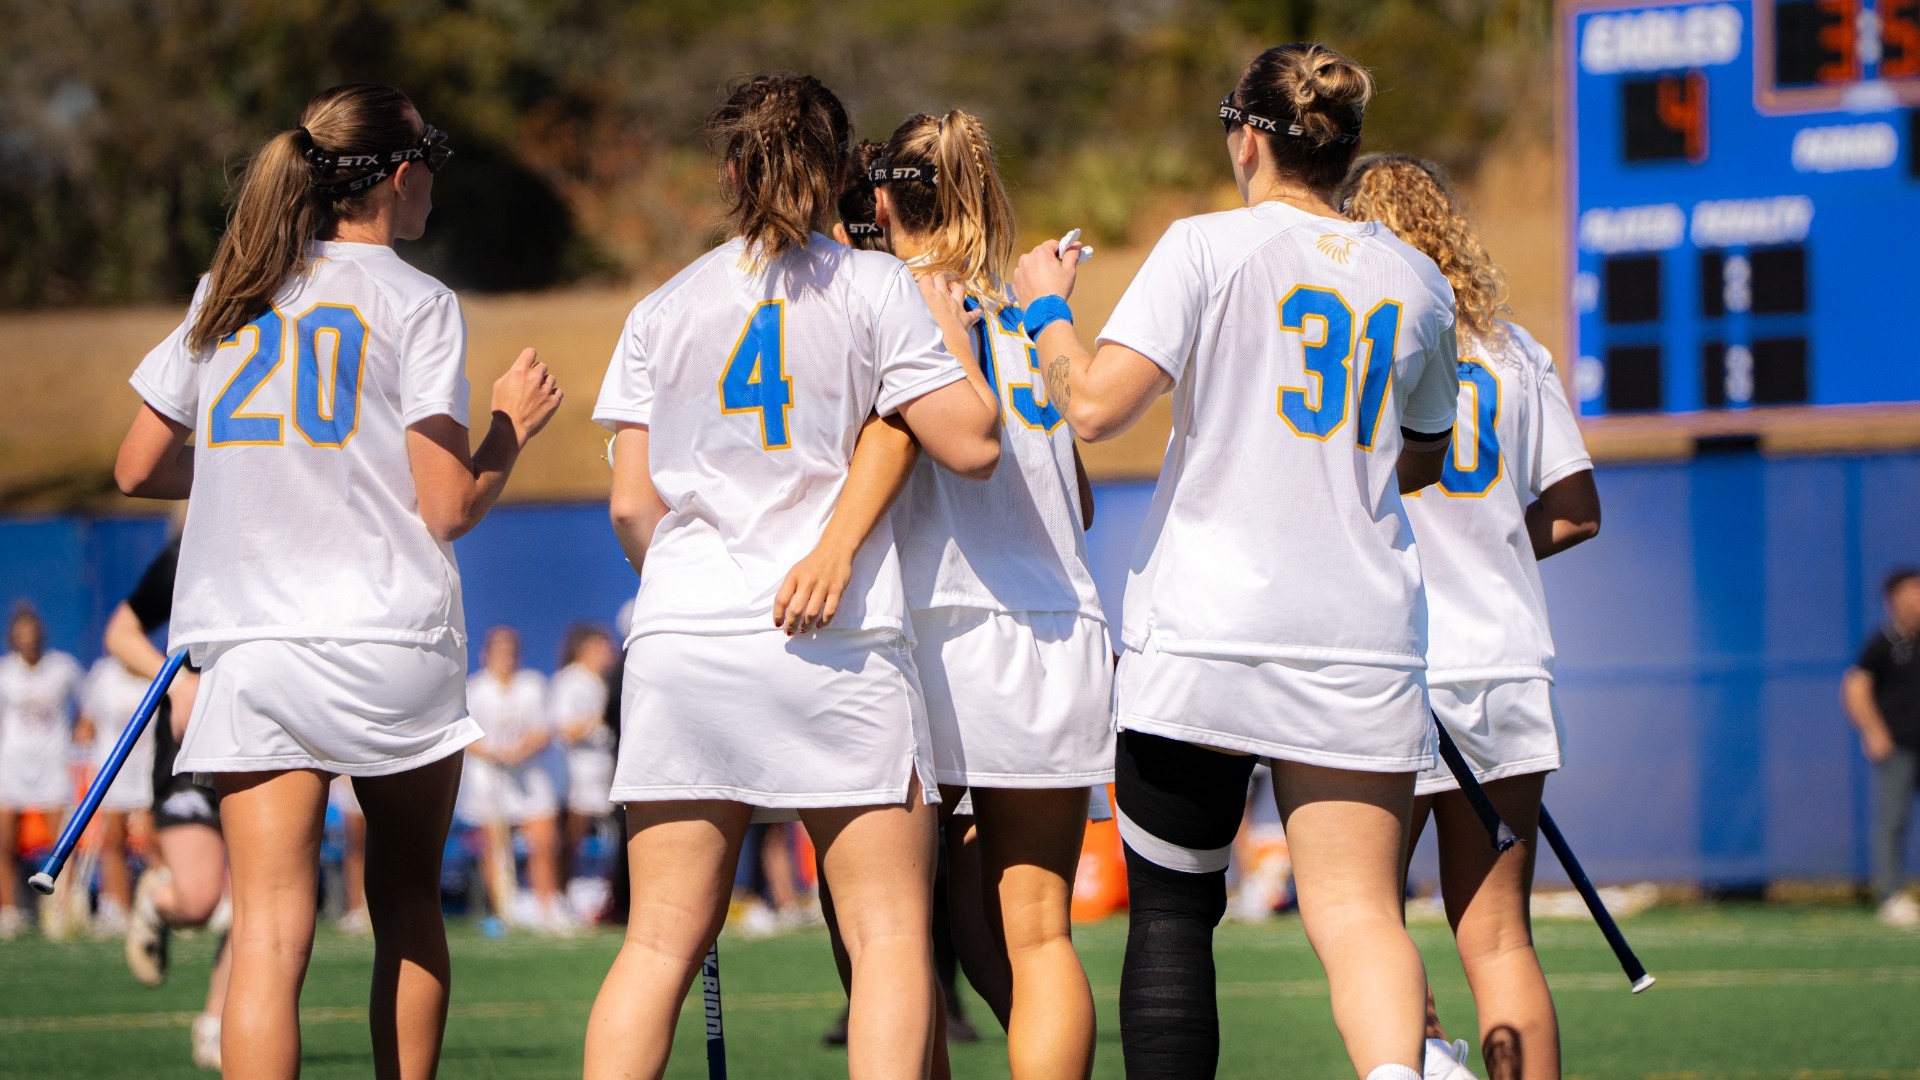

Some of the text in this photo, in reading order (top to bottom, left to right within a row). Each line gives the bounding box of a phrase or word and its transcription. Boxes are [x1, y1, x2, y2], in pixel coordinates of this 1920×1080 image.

[1220, 106, 1241, 122] STX
[1248, 114, 1276, 132] STX
[1656, 68, 1709, 164] 4
[337, 147, 424, 167] STX STX
[349, 168, 387, 191] STX
[874, 168, 887, 180] STX
[849, 222, 878, 234] STX
[207, 301, 370, 450] 20
[717, 298, 794, 452] 4
[1277, 282, 1404, 453] 31
[1401, 357, 1503, 498] 0
